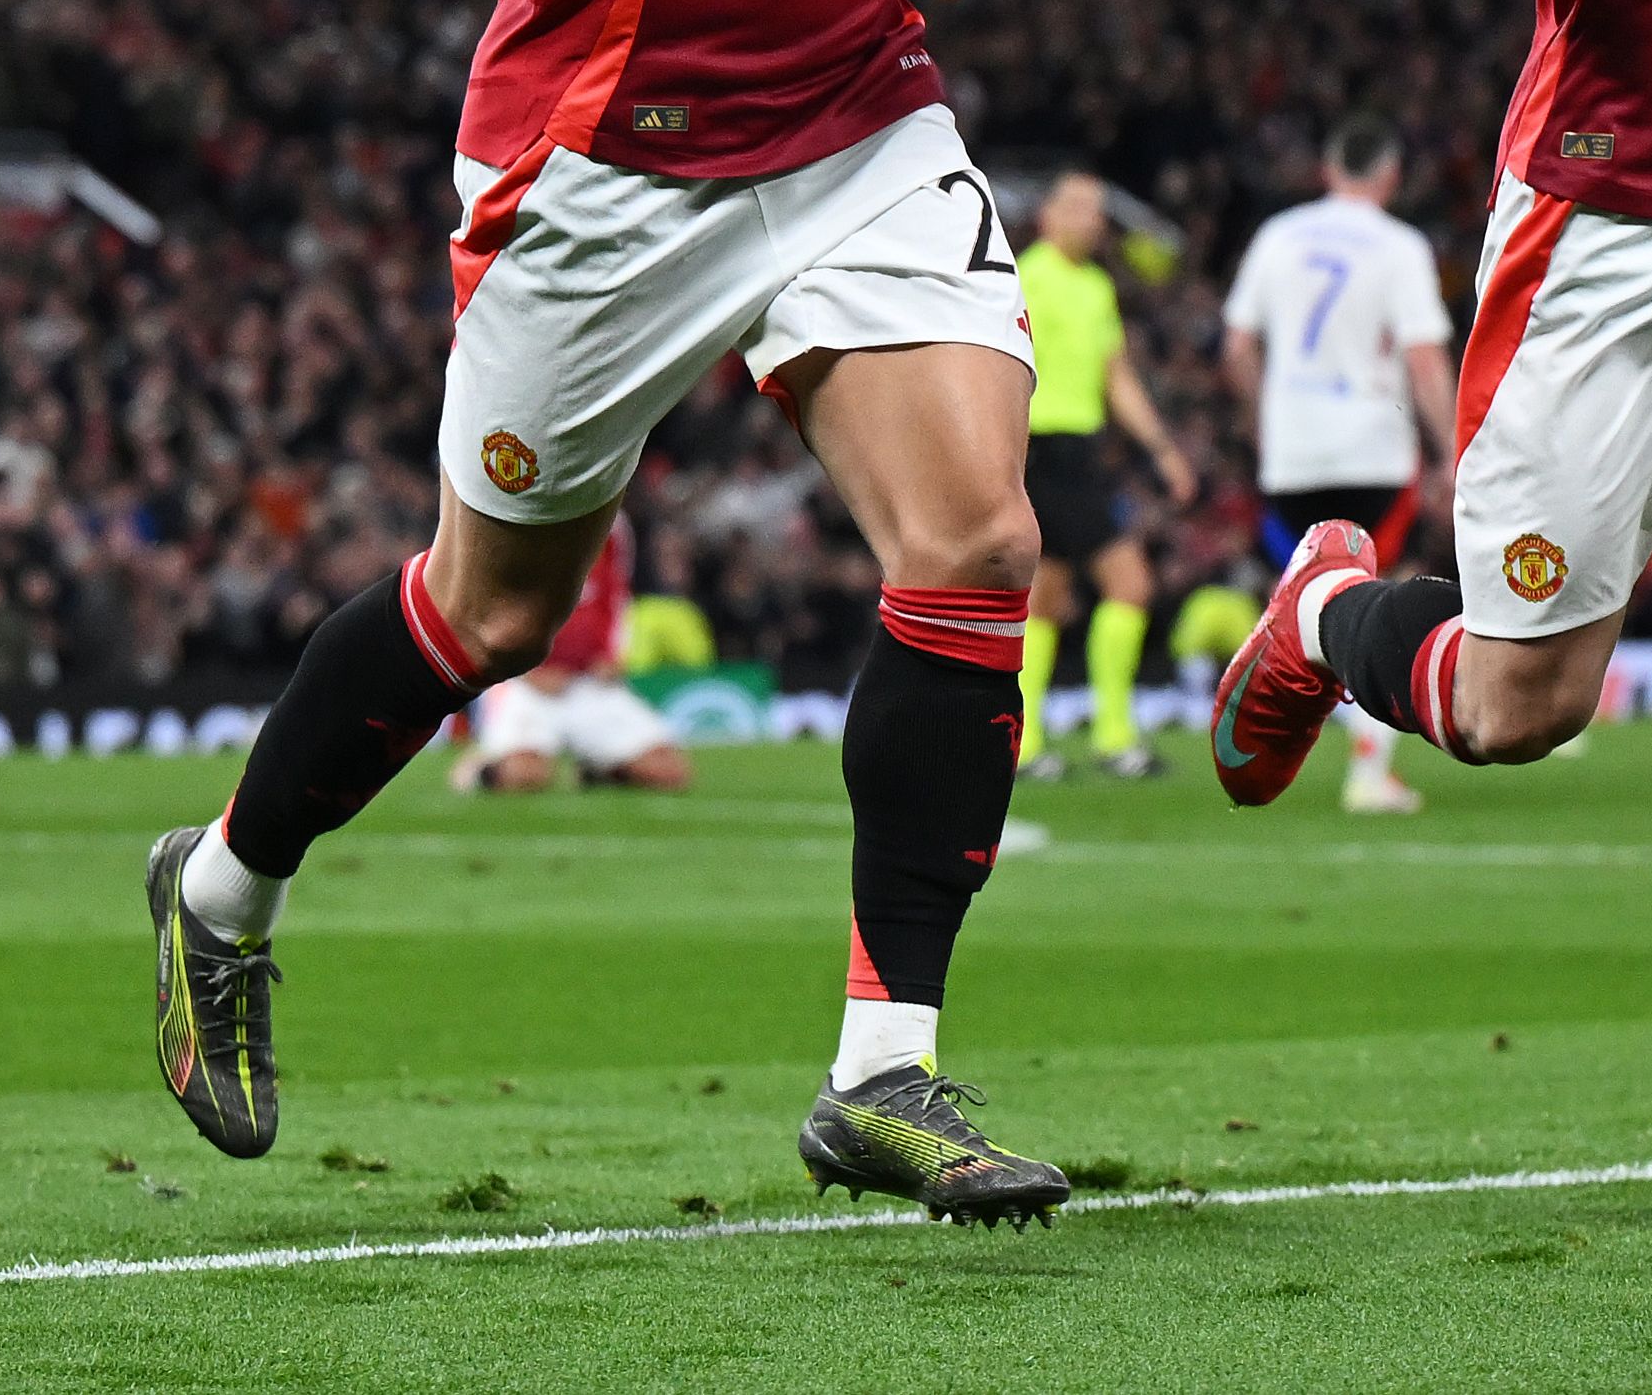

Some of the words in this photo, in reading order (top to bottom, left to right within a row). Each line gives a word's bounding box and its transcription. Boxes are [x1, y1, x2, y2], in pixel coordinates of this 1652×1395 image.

[1304, 254, 1350, 356] 7
[1507, 539, 1560, 562] MANCHESTER
[1517, 586, 1554, 597] UNITED
